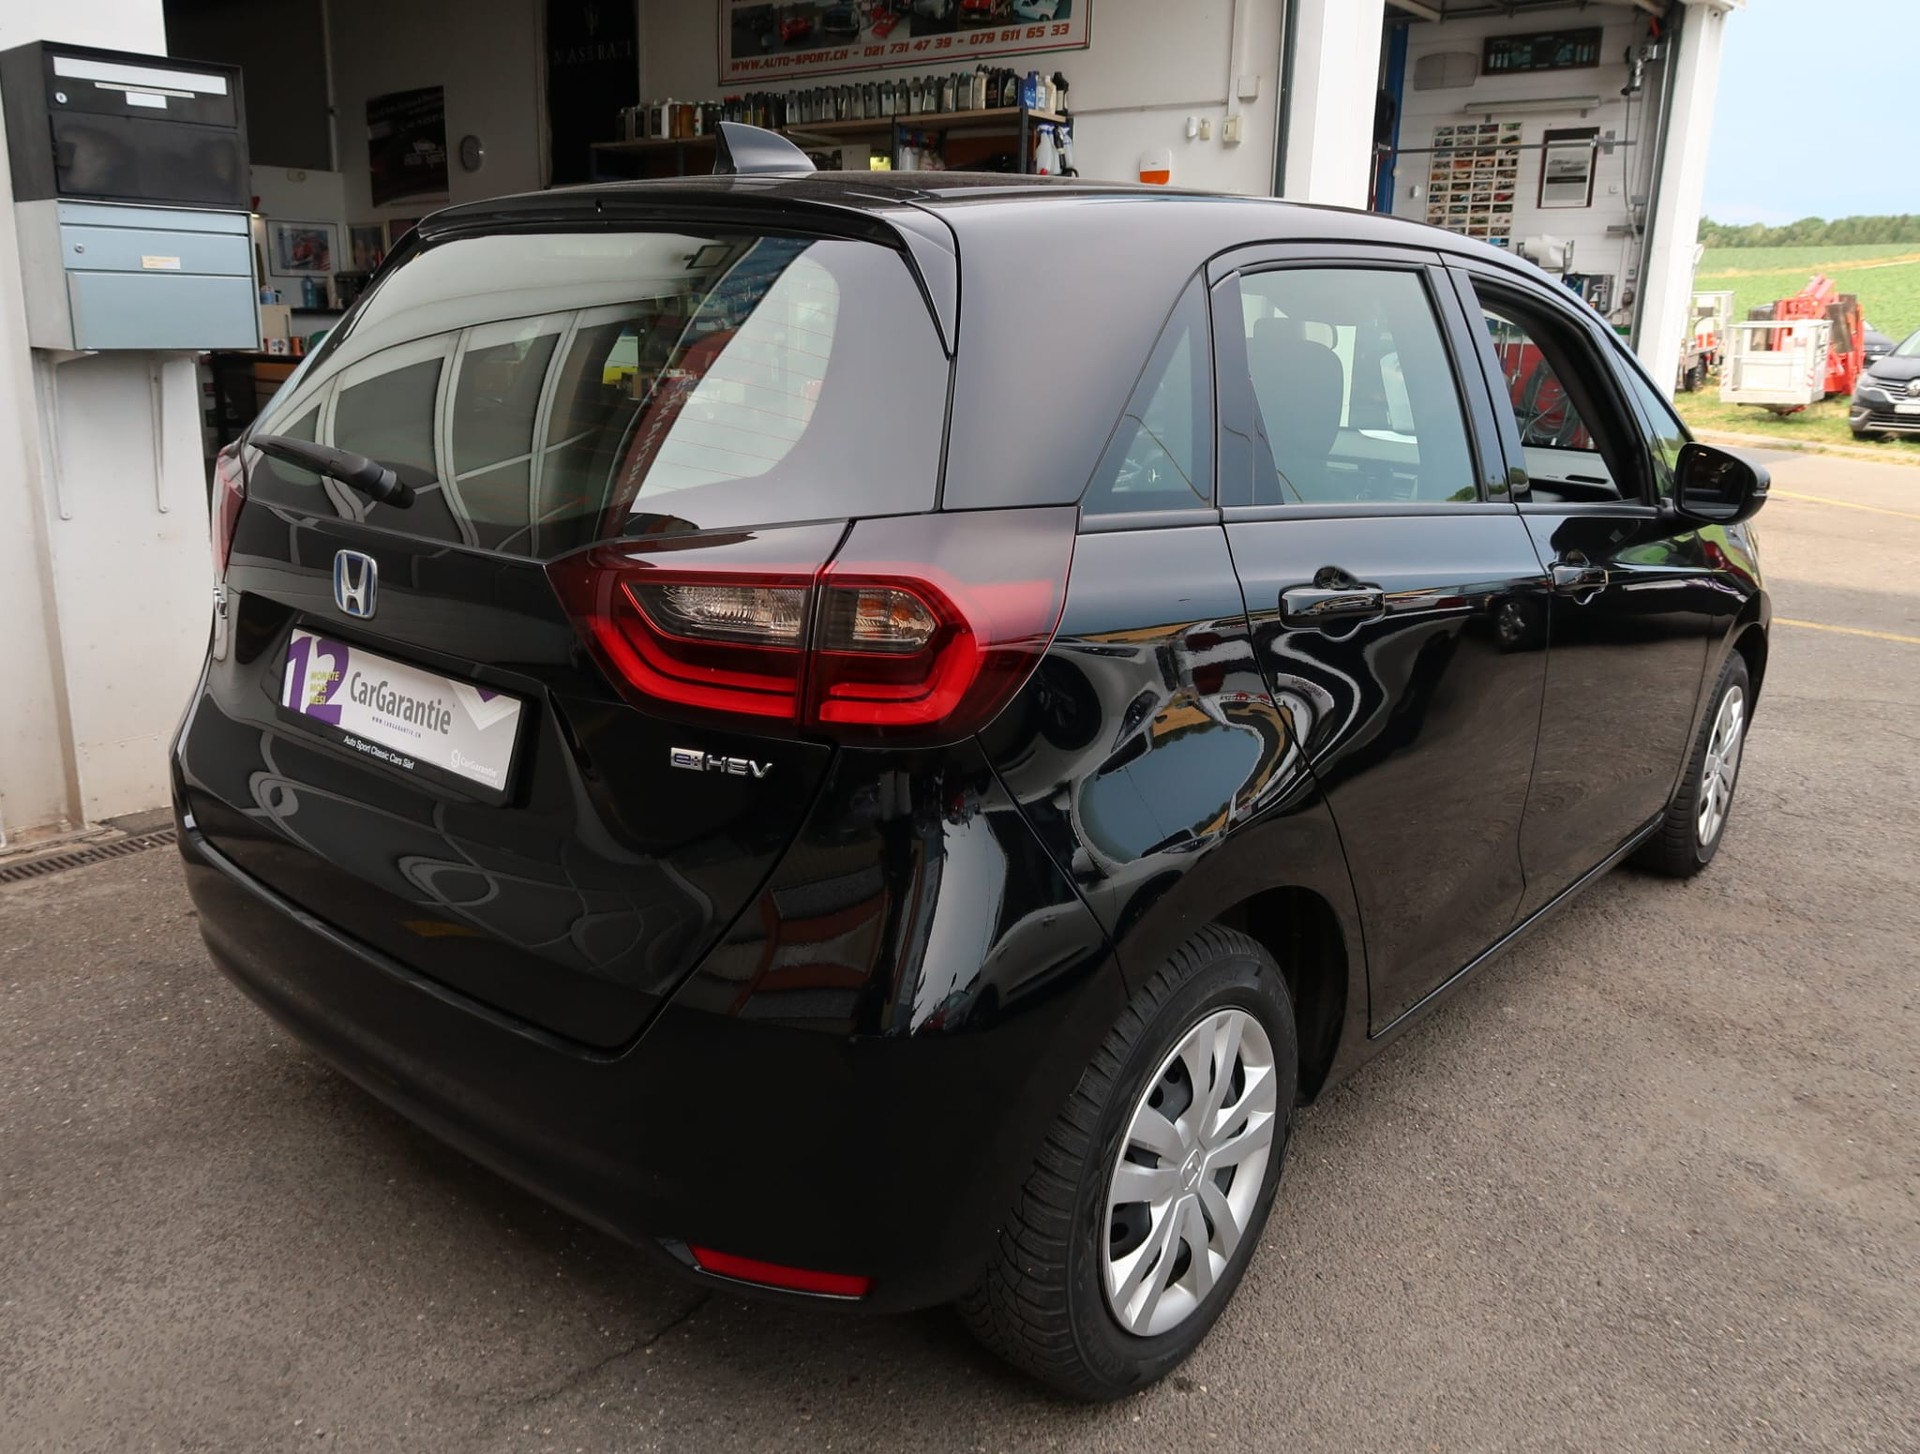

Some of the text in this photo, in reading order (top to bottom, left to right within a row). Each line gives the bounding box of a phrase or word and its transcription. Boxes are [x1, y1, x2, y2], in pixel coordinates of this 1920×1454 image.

[731, 49, 848, 71] WWW.AUTO-SPORT.CH
[864, 44, 885, 58] 021
[890, 41, 909, 55] 731
[914, 39, 931, 52] 47
[935, 36, 951, 49] 39
[969, 31, 996, 45] 079
[1001, 28, 1021, 42] 611
[1026, 25, 1046, 39] 65
[1050, 22, 1070, 36] 33
[287, 636, 349, 725] 12
[350, 671, 452, 735] CarGarantie
[343, 735, 356, 747] Auto
[356, 740, 371, 753] Sport
[370, 745, 390, 761] Classic
[389, 753, 403, 766] Cars
